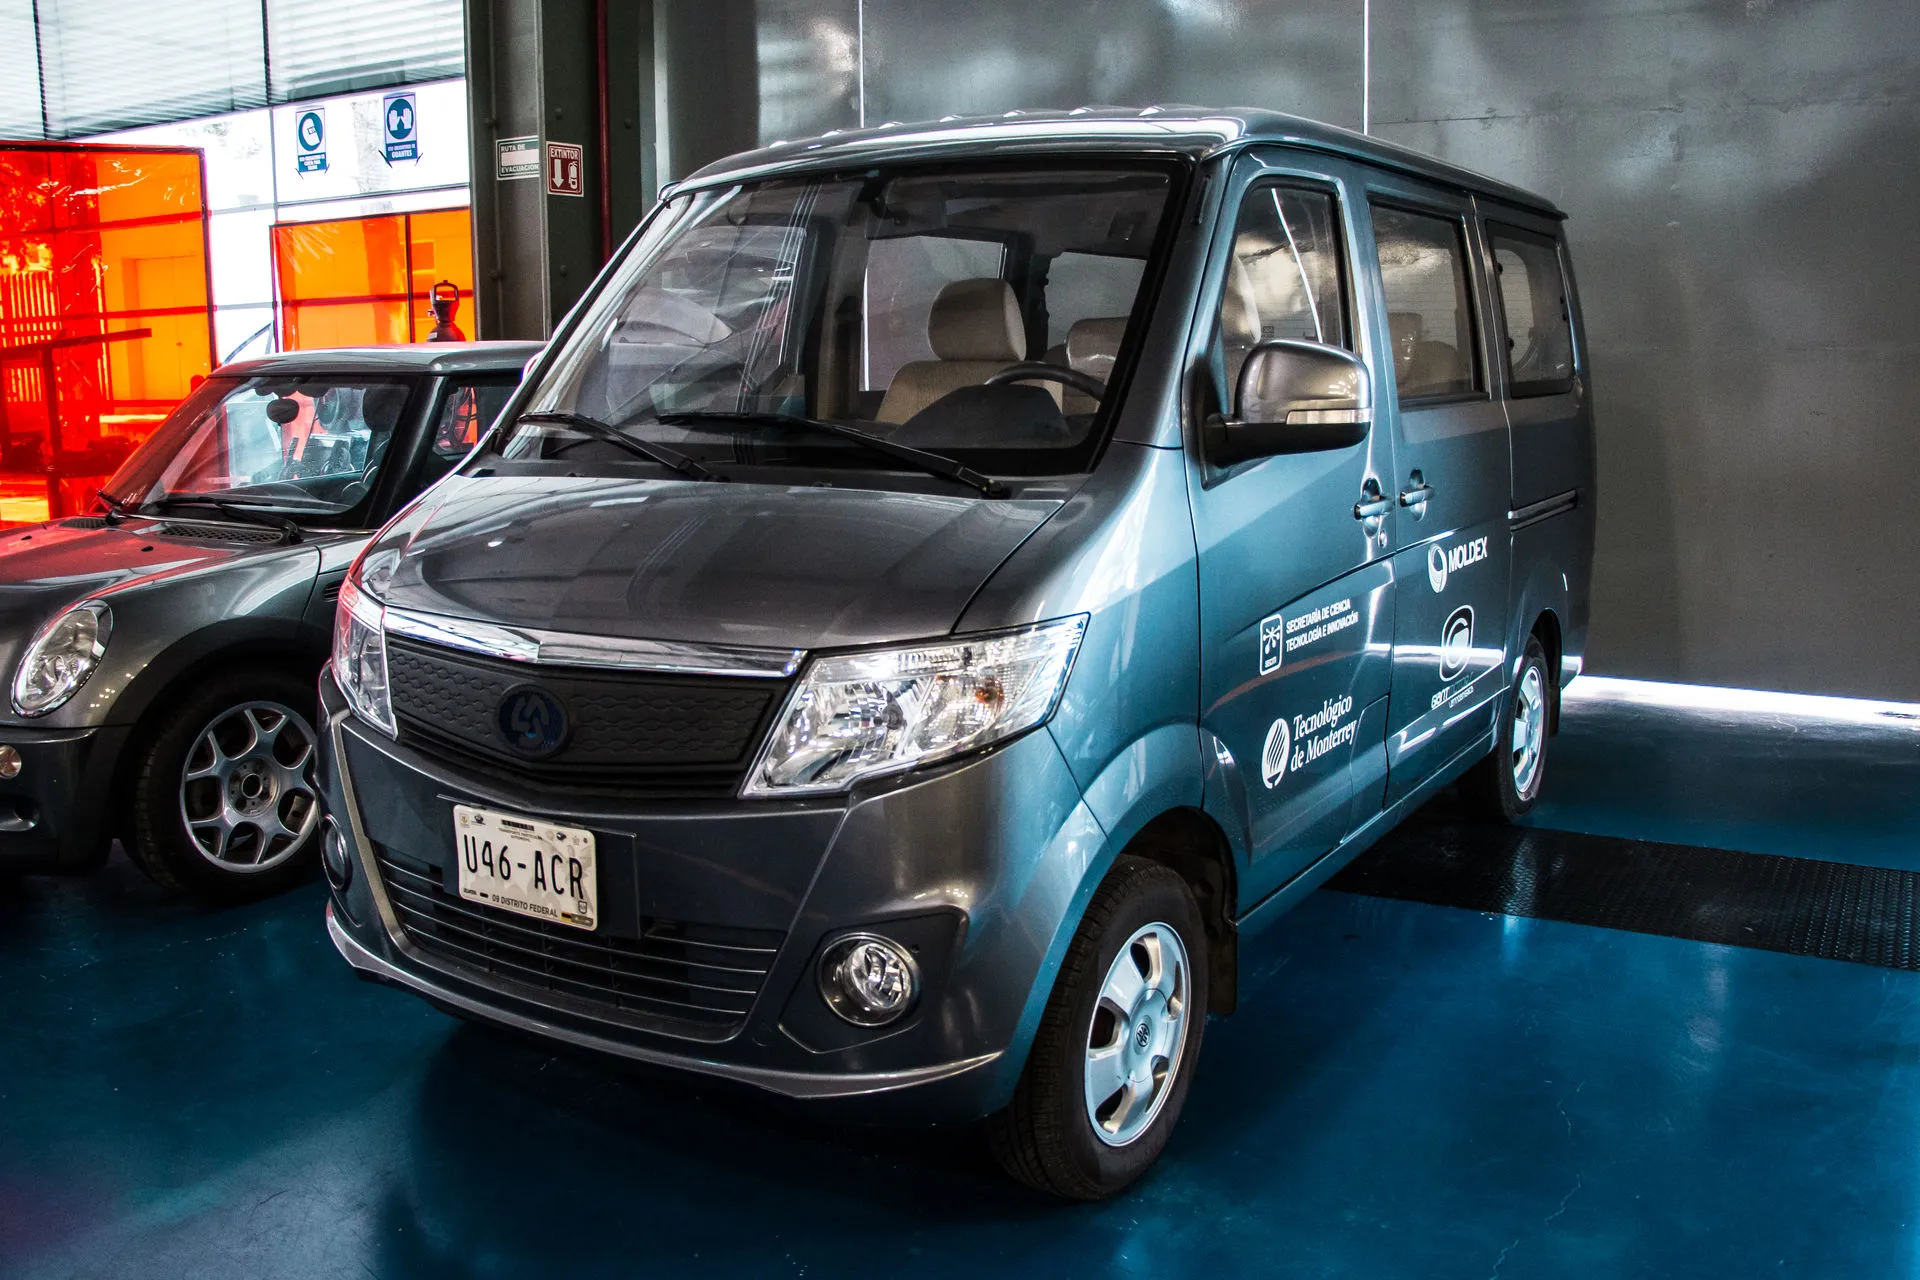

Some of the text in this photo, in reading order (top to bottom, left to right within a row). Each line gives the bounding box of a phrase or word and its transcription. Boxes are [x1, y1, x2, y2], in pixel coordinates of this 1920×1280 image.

[550, 148, 579, 159] EXTINTOR
[1448, 536, 1488, 573] MOLDEX
[1286, 598, 1351, 634] SECRETARÍA DE CIENCIA
[1286, 626, 1322, 652] TECNOLOGÍA
[1327, 610, 1359, 635] INNOVACIÓN
[1293, 694, 1353, 741] Tecnológico
[1290, 720, 1358, 772] de Monterrey
[463, 834, 584, 900] U46-ACR
[492, 894, 558, 918] 09 DISTRITO FEDERAL
